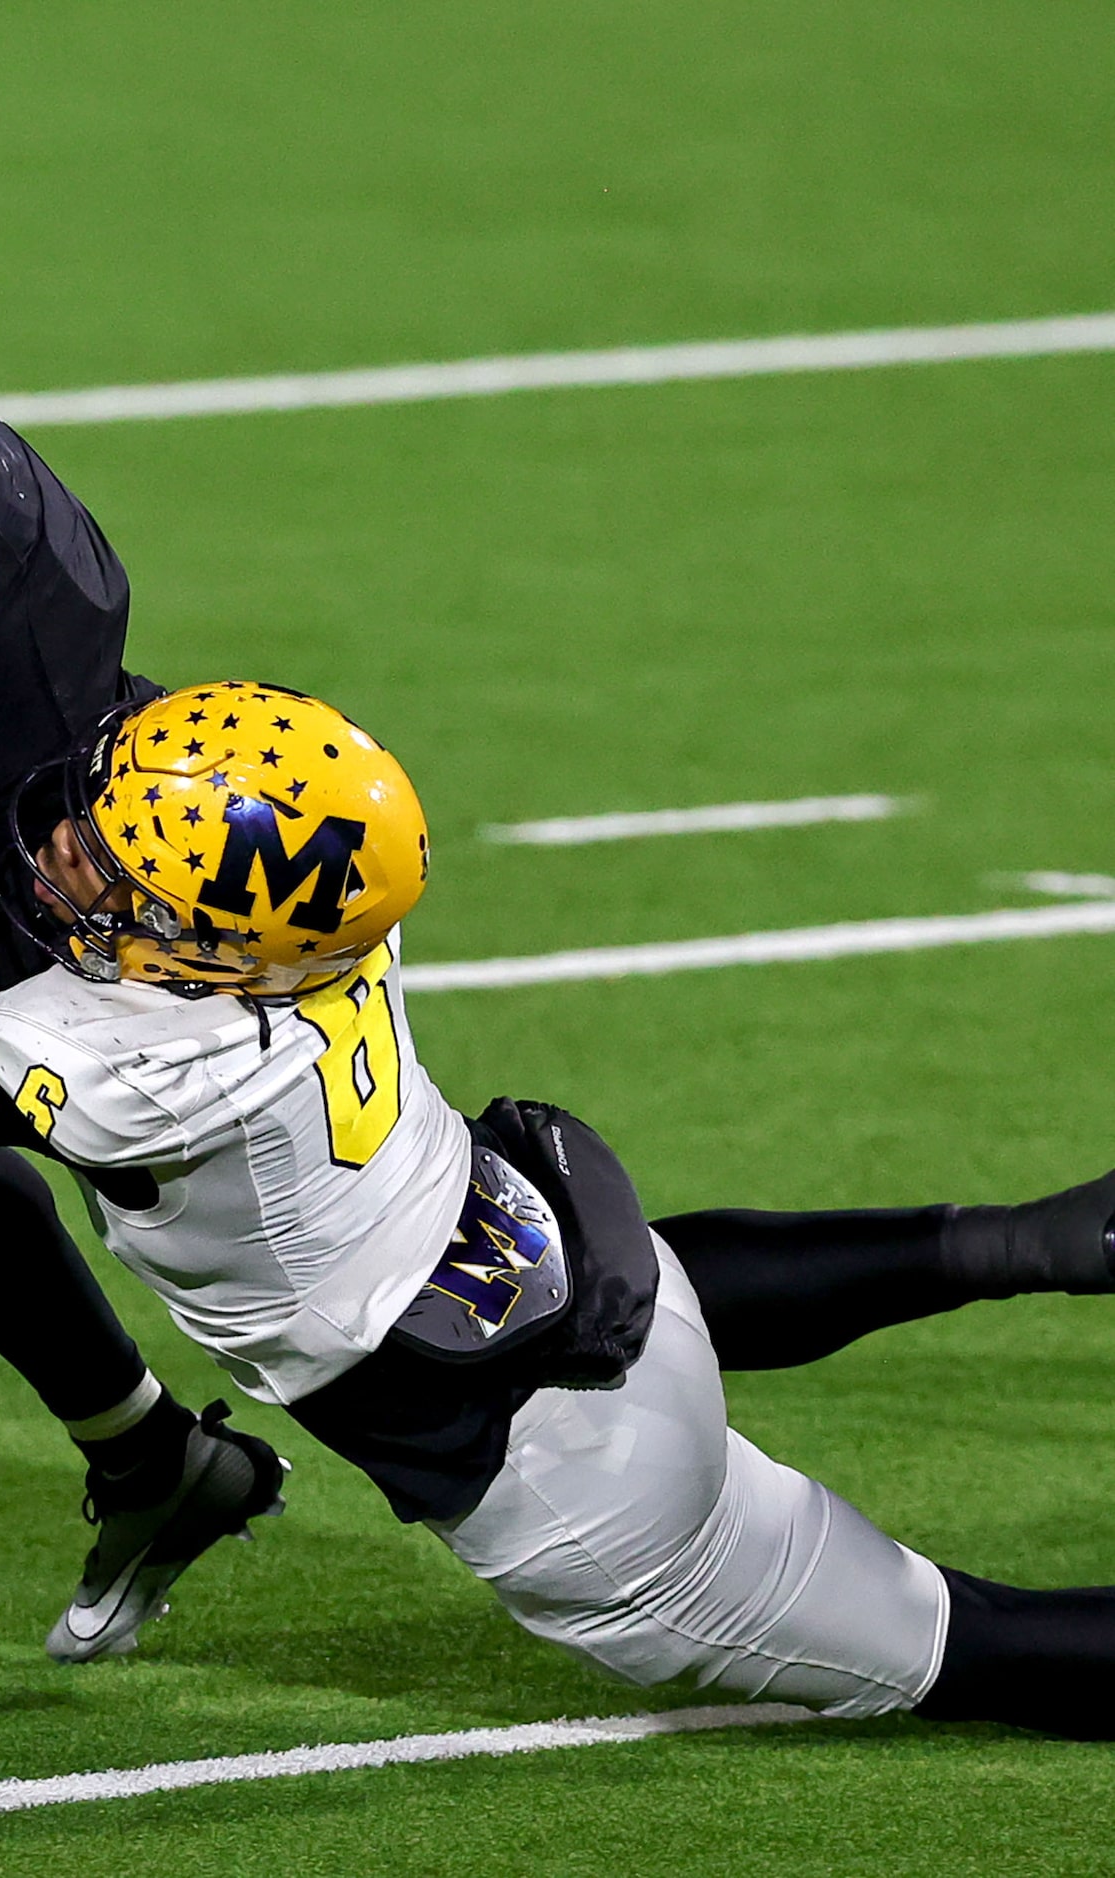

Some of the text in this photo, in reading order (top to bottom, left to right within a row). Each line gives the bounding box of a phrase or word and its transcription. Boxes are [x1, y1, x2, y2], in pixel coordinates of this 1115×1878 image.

[197, 793, 366, 934] M
[14, 1063, 68, 1140] 6
[429, 1180, 550, 1338] M
